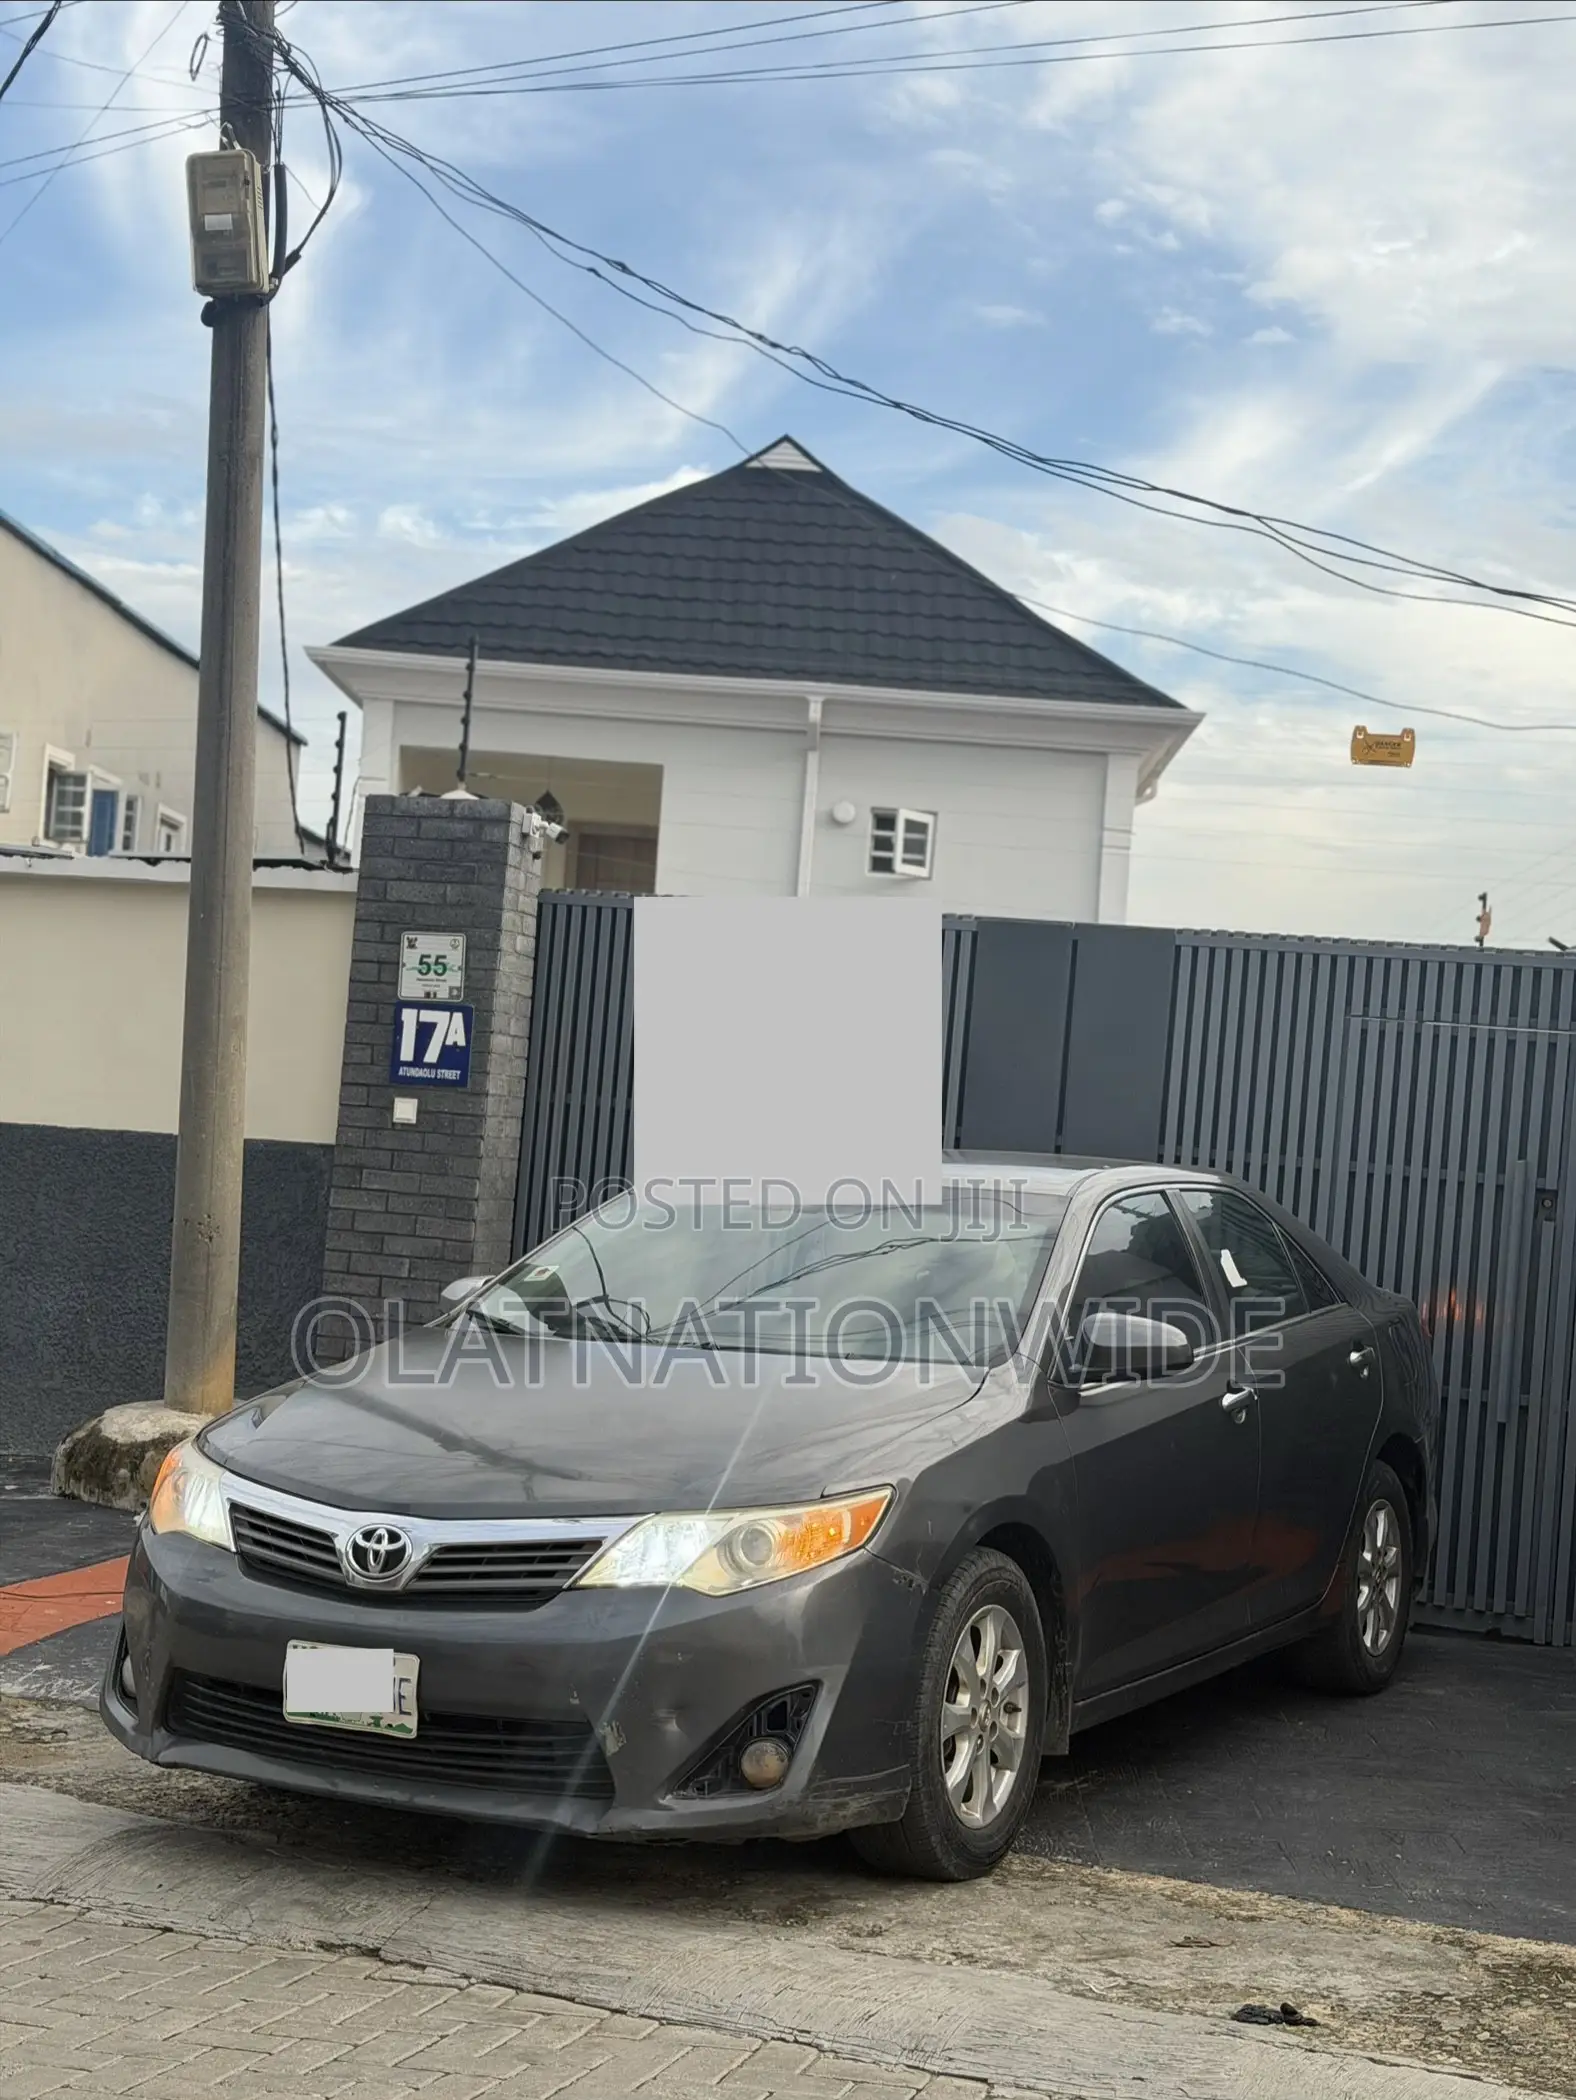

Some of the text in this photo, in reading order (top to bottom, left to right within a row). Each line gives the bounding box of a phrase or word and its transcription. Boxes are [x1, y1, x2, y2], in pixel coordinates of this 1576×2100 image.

[418, 954, 448, 977] 55
[400, 1008, 466, 1064] 17A
[436, 1068, 462, 1080] STREET
